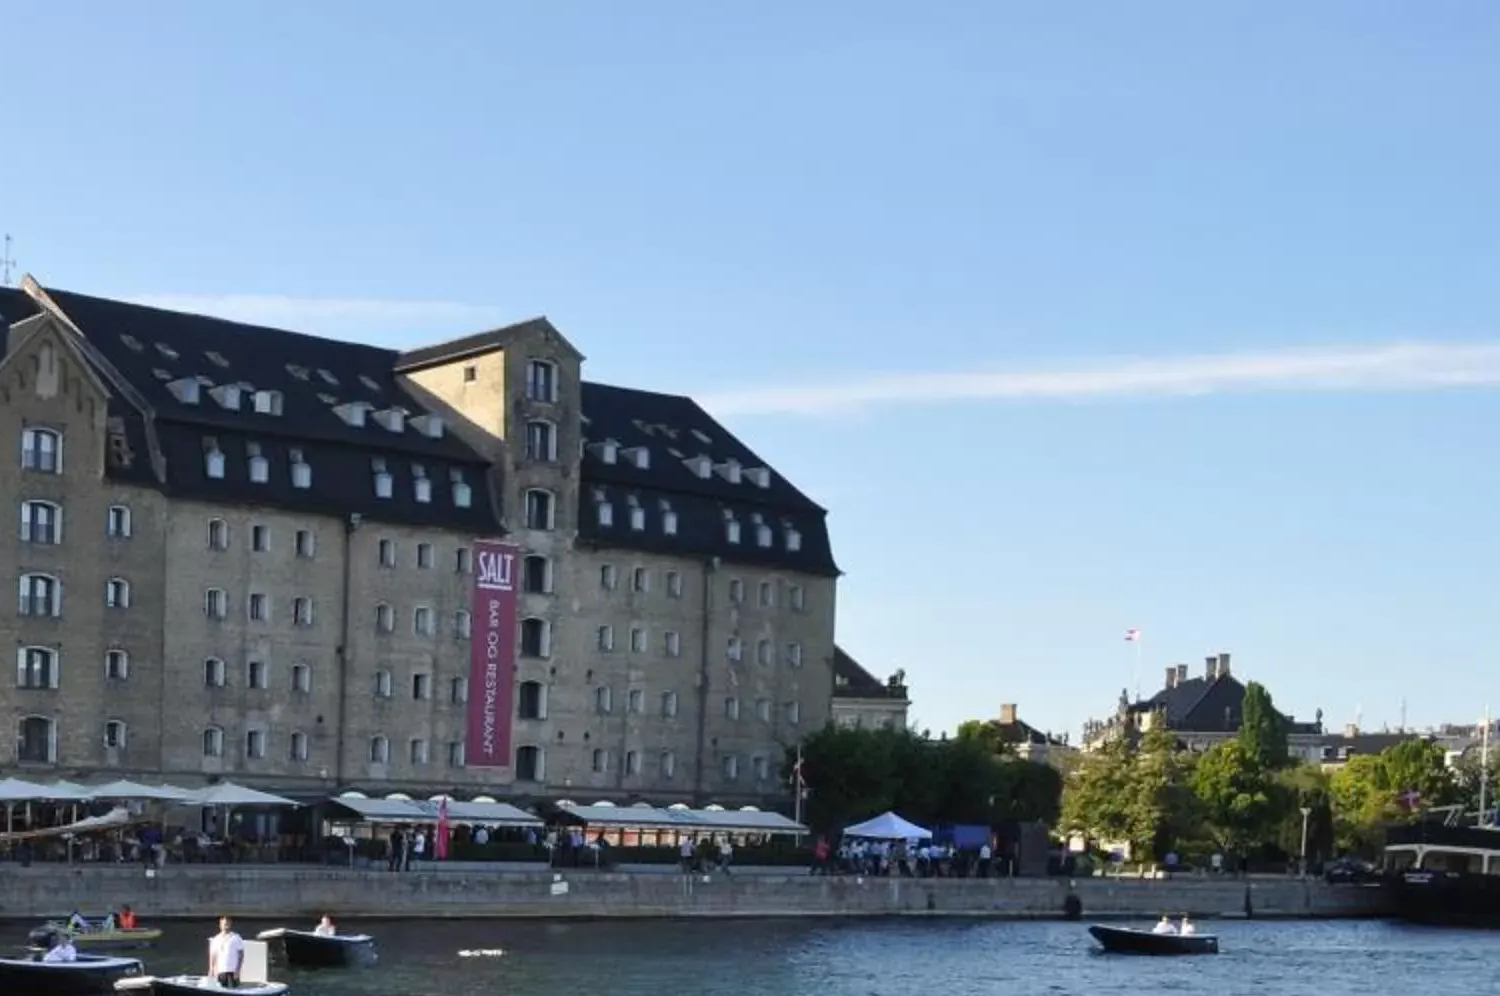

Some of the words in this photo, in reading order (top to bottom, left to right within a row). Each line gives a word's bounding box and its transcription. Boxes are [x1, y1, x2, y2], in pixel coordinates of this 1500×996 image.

[478, 551, 514, 584] SALT
[488, 600, 500, 628] BAR
[487, 632, 499, 659] OG
[483, 663, 497, 755] RESTAURANT
